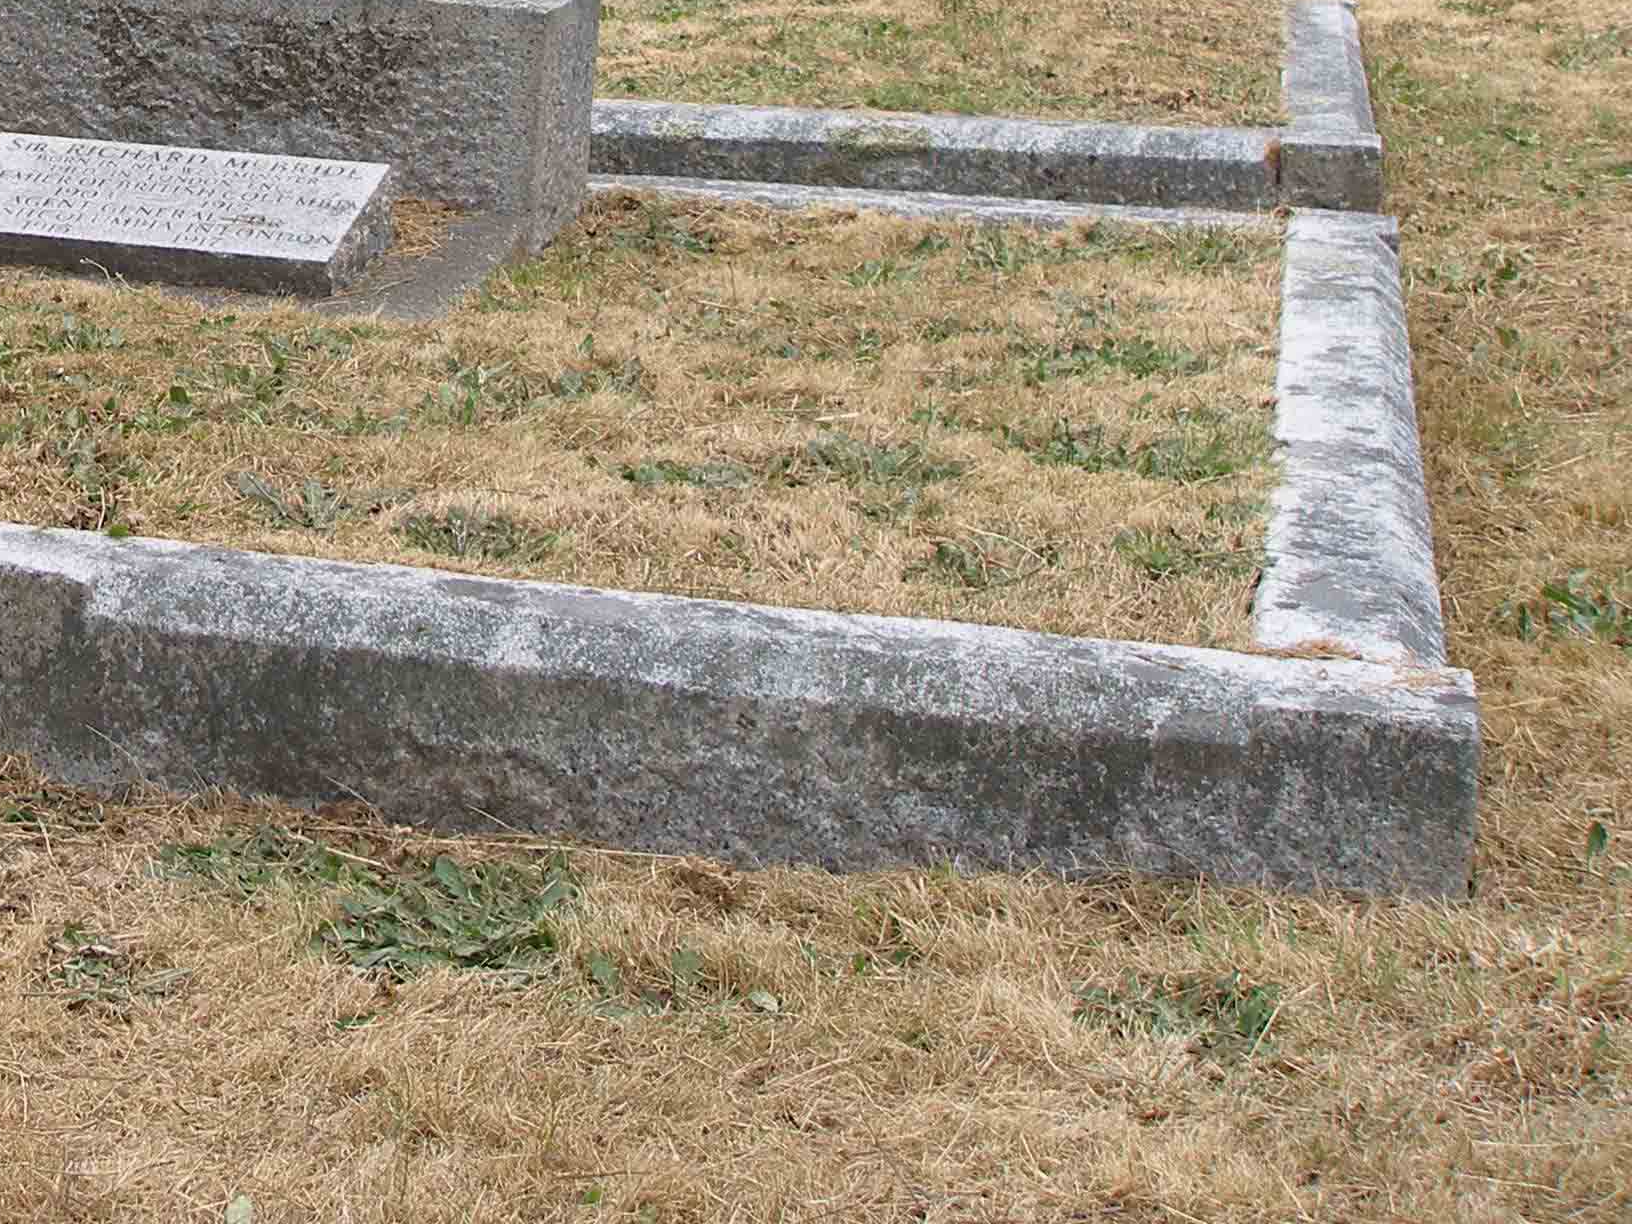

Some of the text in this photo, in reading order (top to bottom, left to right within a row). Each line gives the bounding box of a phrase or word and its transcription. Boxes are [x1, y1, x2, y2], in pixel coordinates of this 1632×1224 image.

[6, 137, 48, 153] SIR
[66, 143, 208, 165] RICHARD
[36, 153, 90, 165] BORN
[98, 159, 118, 167] IN
[132, 161, 171, 172] NEW
[110, 169, 130, 178] IN
[148, 173, 232, 187] LONDON
[78, 176, 110, 188] OF
[115, 180, 215, 197] BRITISH
[221, 190, 358, 210] COLUMBIA
[13, 195, 90, 210] AGENT
[100, 203, 216, 222] GENERAL
[37, 208, 172, 231] COLUMBIA
[185, 222, 216, 234] IN
[218, 224, 334, 245] LONDON
